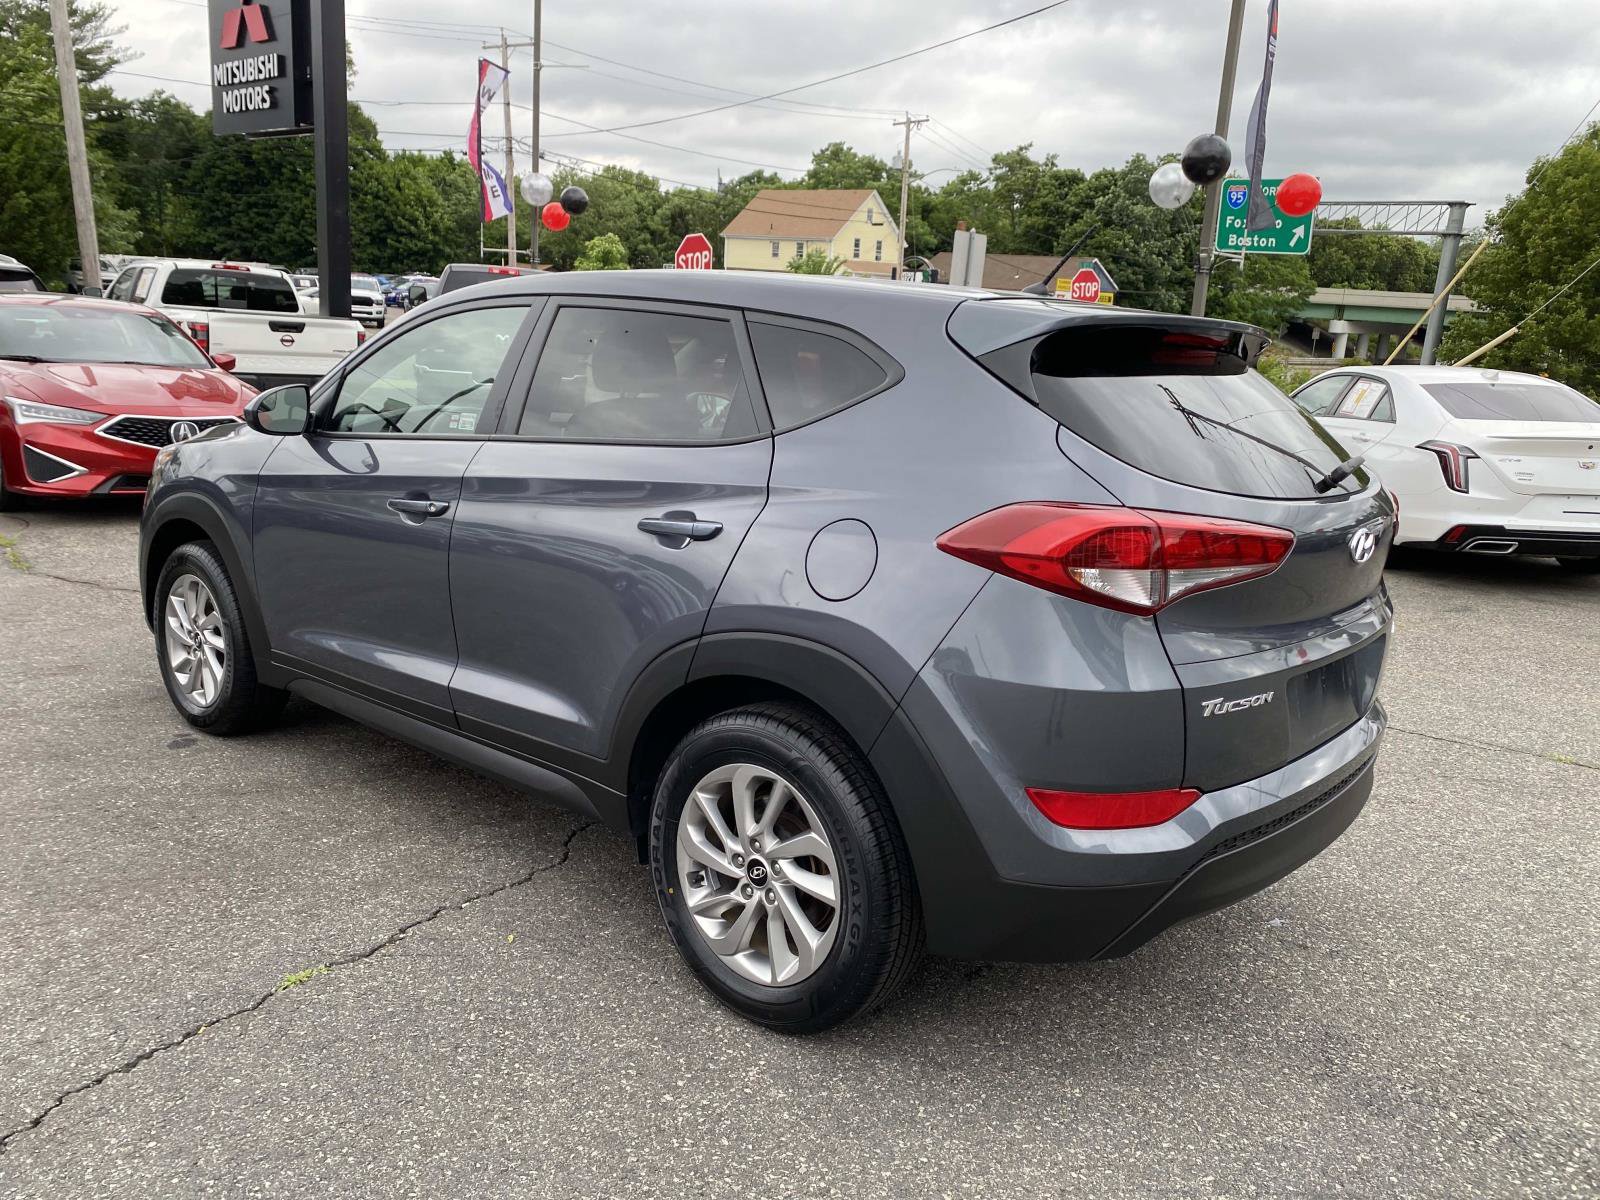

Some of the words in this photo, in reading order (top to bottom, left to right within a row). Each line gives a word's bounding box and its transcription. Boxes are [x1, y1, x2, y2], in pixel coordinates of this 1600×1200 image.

[213, 53, 279, 87] MITSUBISHI
[222, 84, 271, 114] MOTORS
[1230, 191, 1244, 203] 95
[1228, 233, 1277, 248] Boston
[678, 250, 710, 270] STOP
[1072, 281, 1099, 298] STOP
